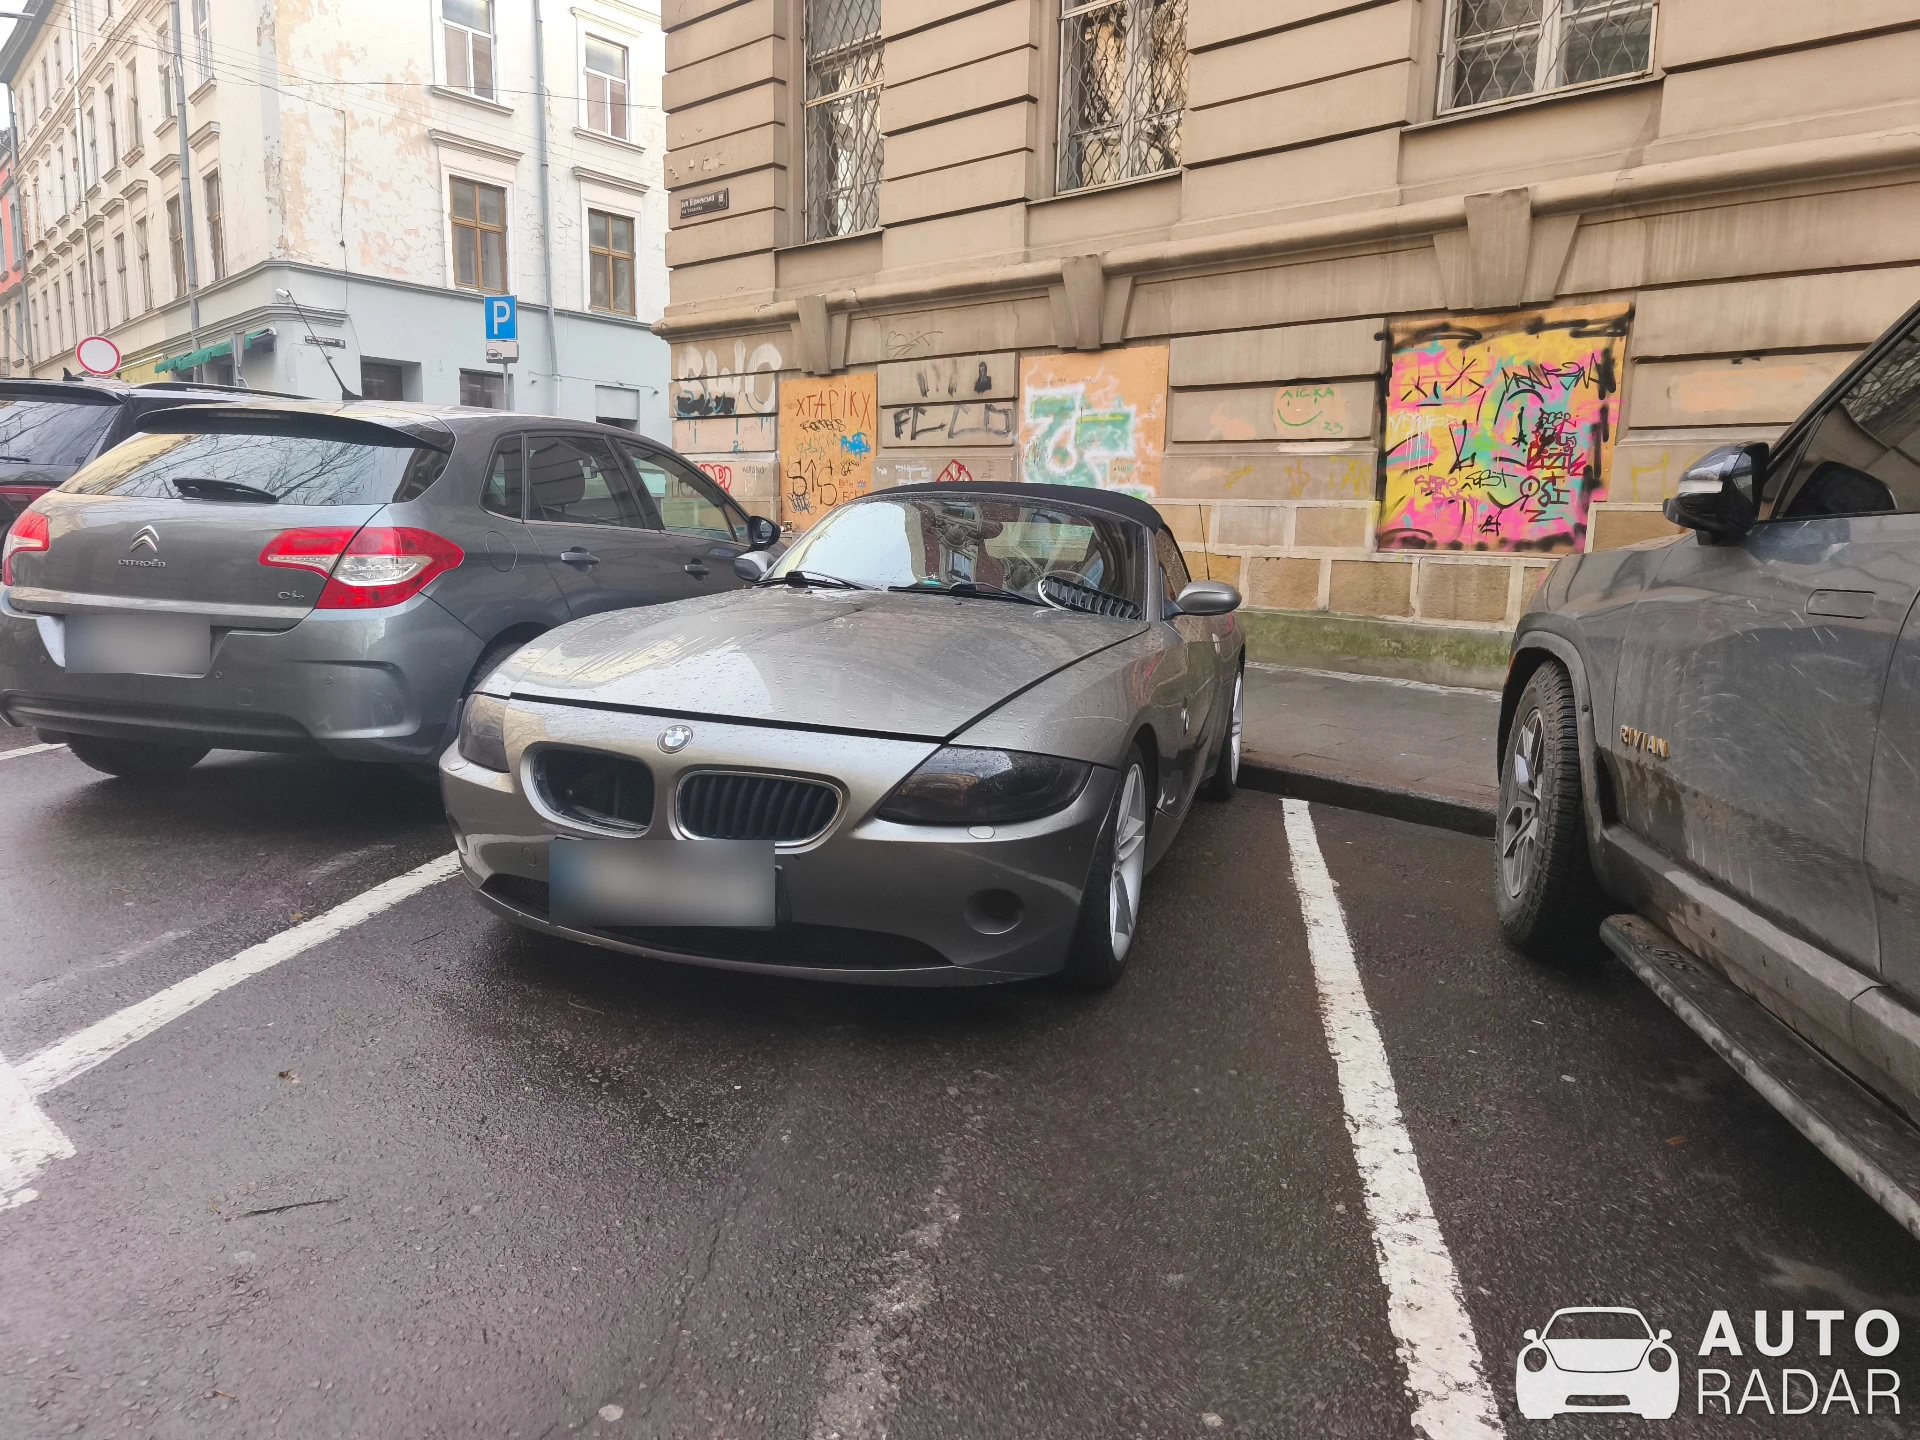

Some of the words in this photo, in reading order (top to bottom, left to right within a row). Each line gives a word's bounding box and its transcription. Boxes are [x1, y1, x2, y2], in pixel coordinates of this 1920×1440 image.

[493, 301, 510, 335] P
[118, 558, 166, 568] CITROËN
[277, 590, 305, 599] C4
[1621, 725, 1669, 758] RIVIAN
